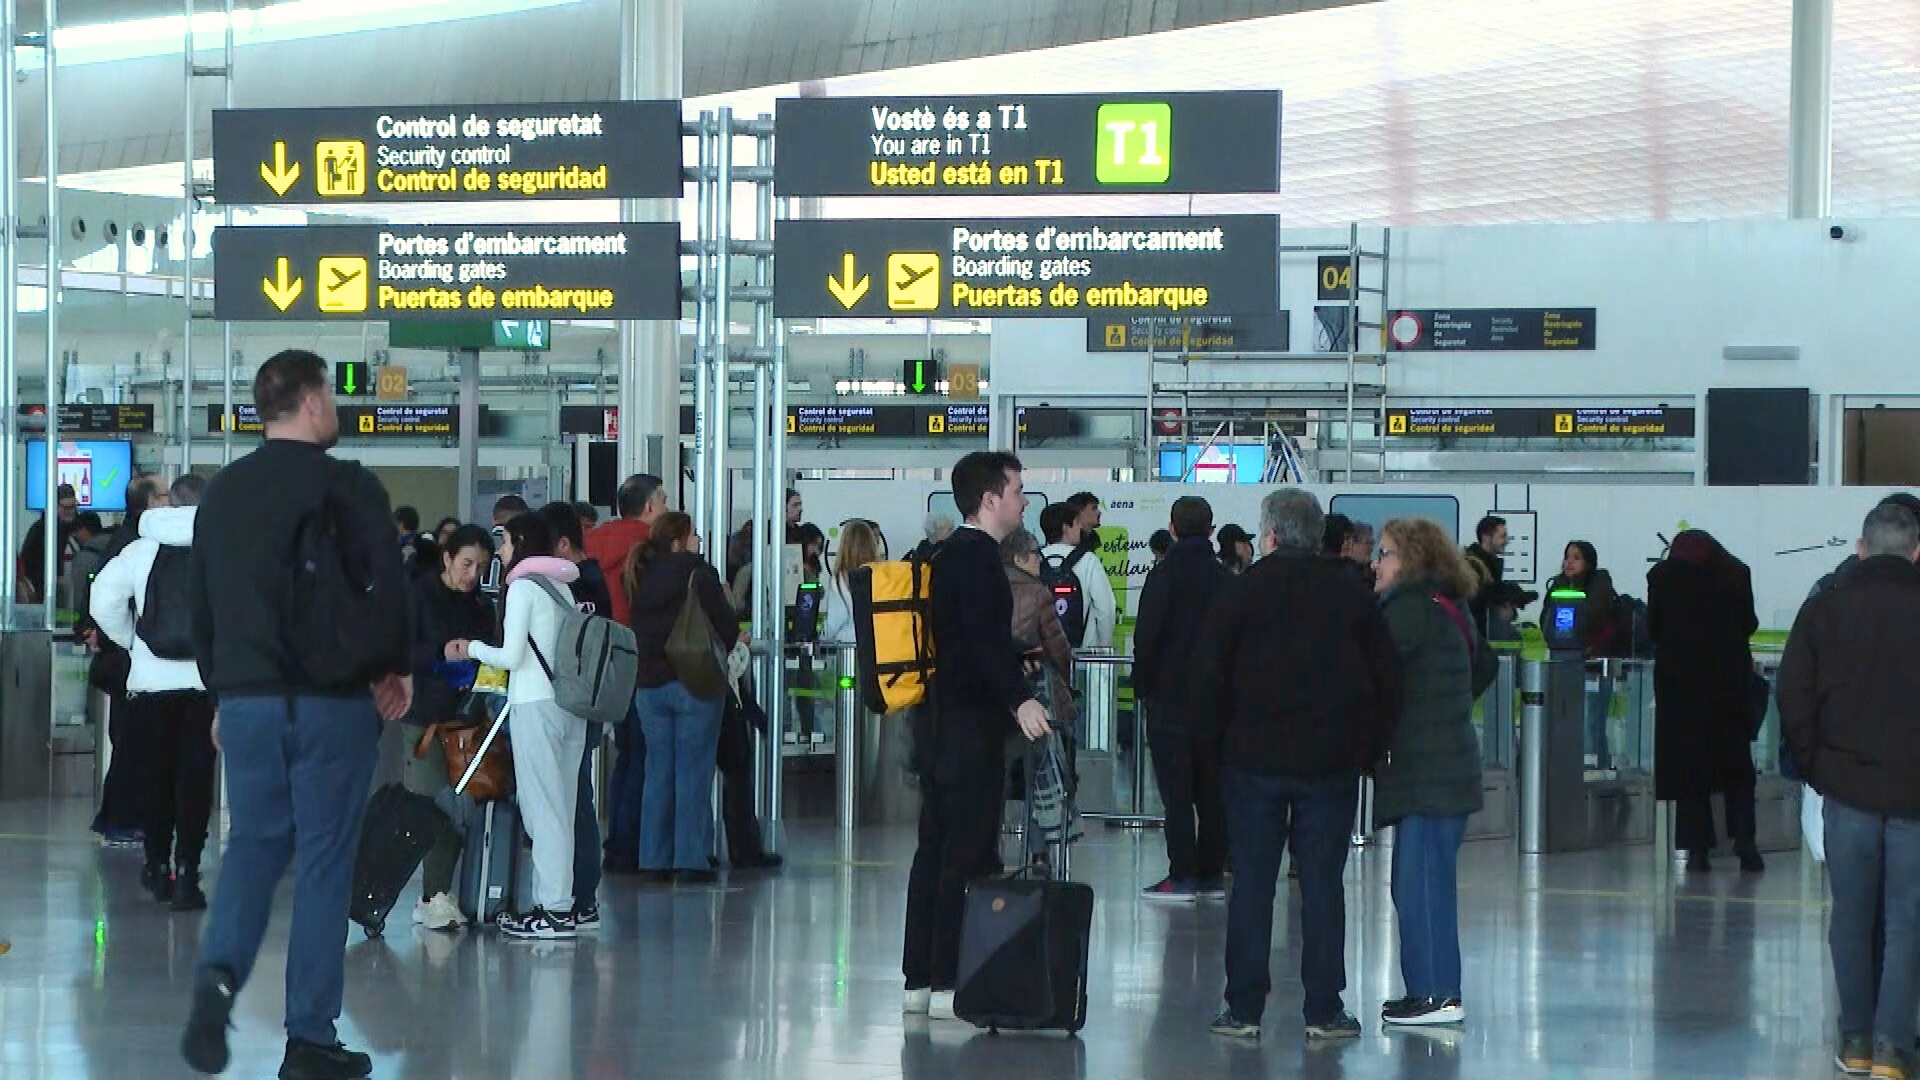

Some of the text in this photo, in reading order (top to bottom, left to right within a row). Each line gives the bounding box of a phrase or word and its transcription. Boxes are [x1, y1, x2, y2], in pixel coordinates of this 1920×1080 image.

[377, 112, 603, 141] Control de seguretat
[872, 103, 1027, 131] Vostè és a T1
[378, 143, 510, 168] Security control
[871, 132, 991, 156] You are in T1
[1105, 121, 1162, 166] T1
[378, 164, 607, 194] Control de seguridad
[871, 159, 1064, 185] Usted está en T1
[379, 231, 627, 256] Portes d'embarcament
[953, 226, 1224, 252] Portes d'embarcament
[380, 259, 507, 283] Boarding gates
[953, 255, 1092, 281] Boarding gates
[1322, 265, 1353, 290] 04
[379, 283, 614, 313] Puertas de embarque
[953, 281, 1208, 311] Puertas de embarque
[382, 373, 404, 392] 02
[953, 372, 976, 391] 03
[799, 407, 826, 416] Control
[948, 406, 976, 416] Control
[799, 423, 826, 433] Control
[838, 423, 875, 436] seguridad
[948, 423, 976, 433] Control
[1410, 423, 1496, 435] Control de seguridad
[1577, 423, 1665, 435] Control de seguridad
[1110, 499, 1135, 509] aena
